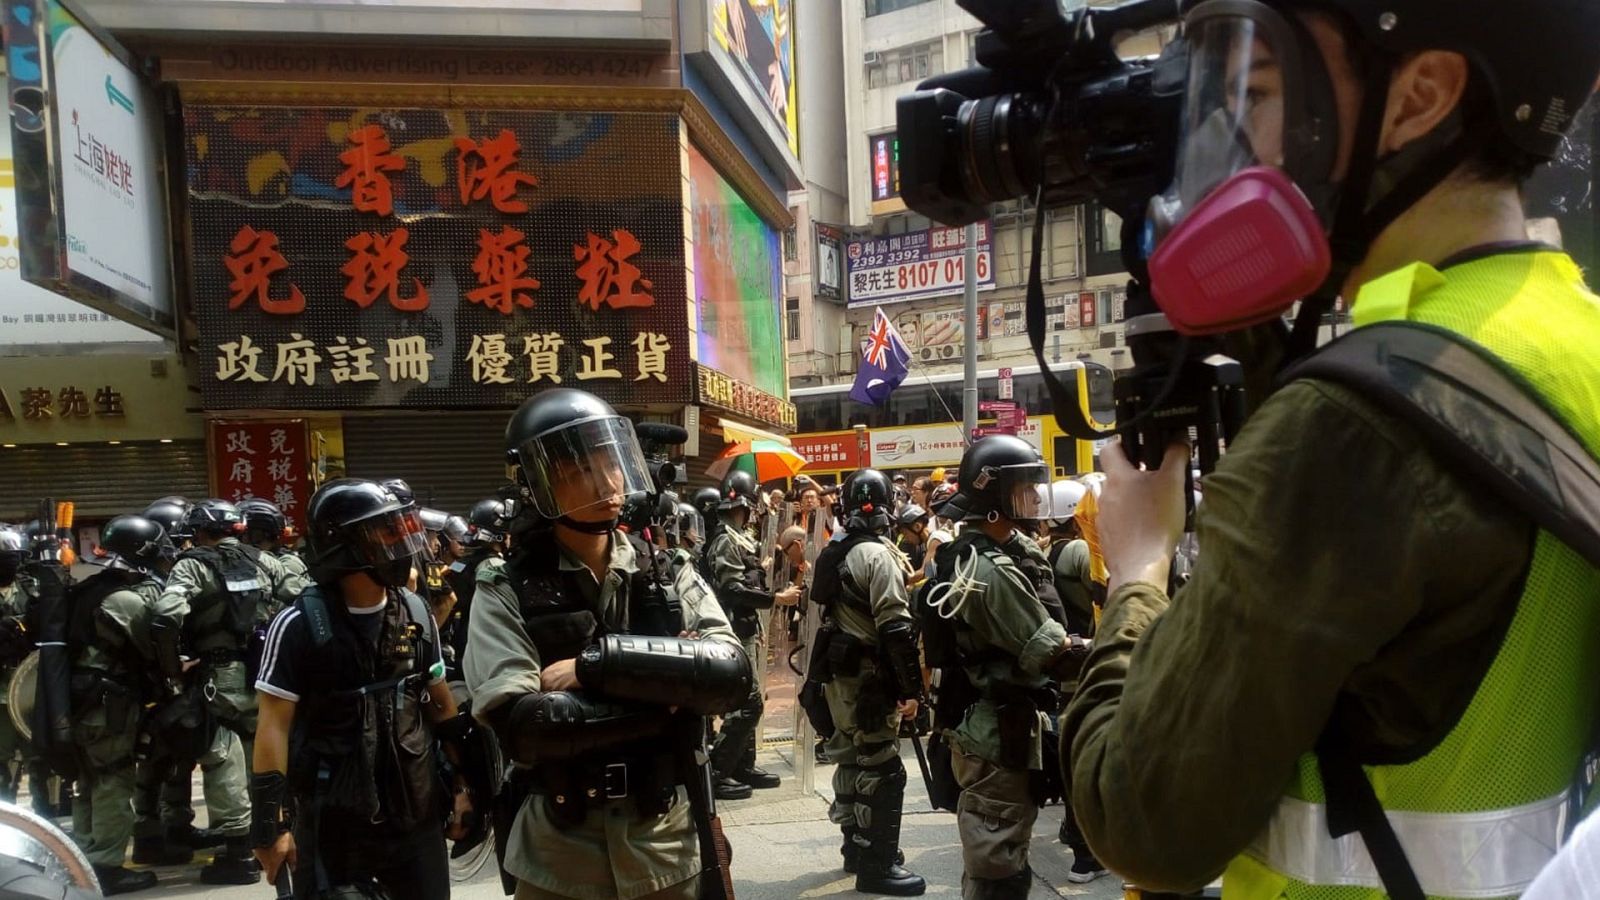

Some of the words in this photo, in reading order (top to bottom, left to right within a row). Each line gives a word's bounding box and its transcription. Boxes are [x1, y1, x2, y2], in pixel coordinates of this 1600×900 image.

[219, 49, 319, 73] Outdoor
[327, 53, 460, 80] Advertising
[466, 55, 534, 77] Lease:
[335, 124, 539, 217] 香港
[852, 254, 883, 268] 2392
[887, 249, 920, 263] 3392
[898, 260, 939, 290] 8107
[944, 253, 987, 283] 016
[854, 270, 896, 294] 黎先生
[215, 333, 435, 386] 政府註冊
[465, 330, 671, 384] 優質正貨
